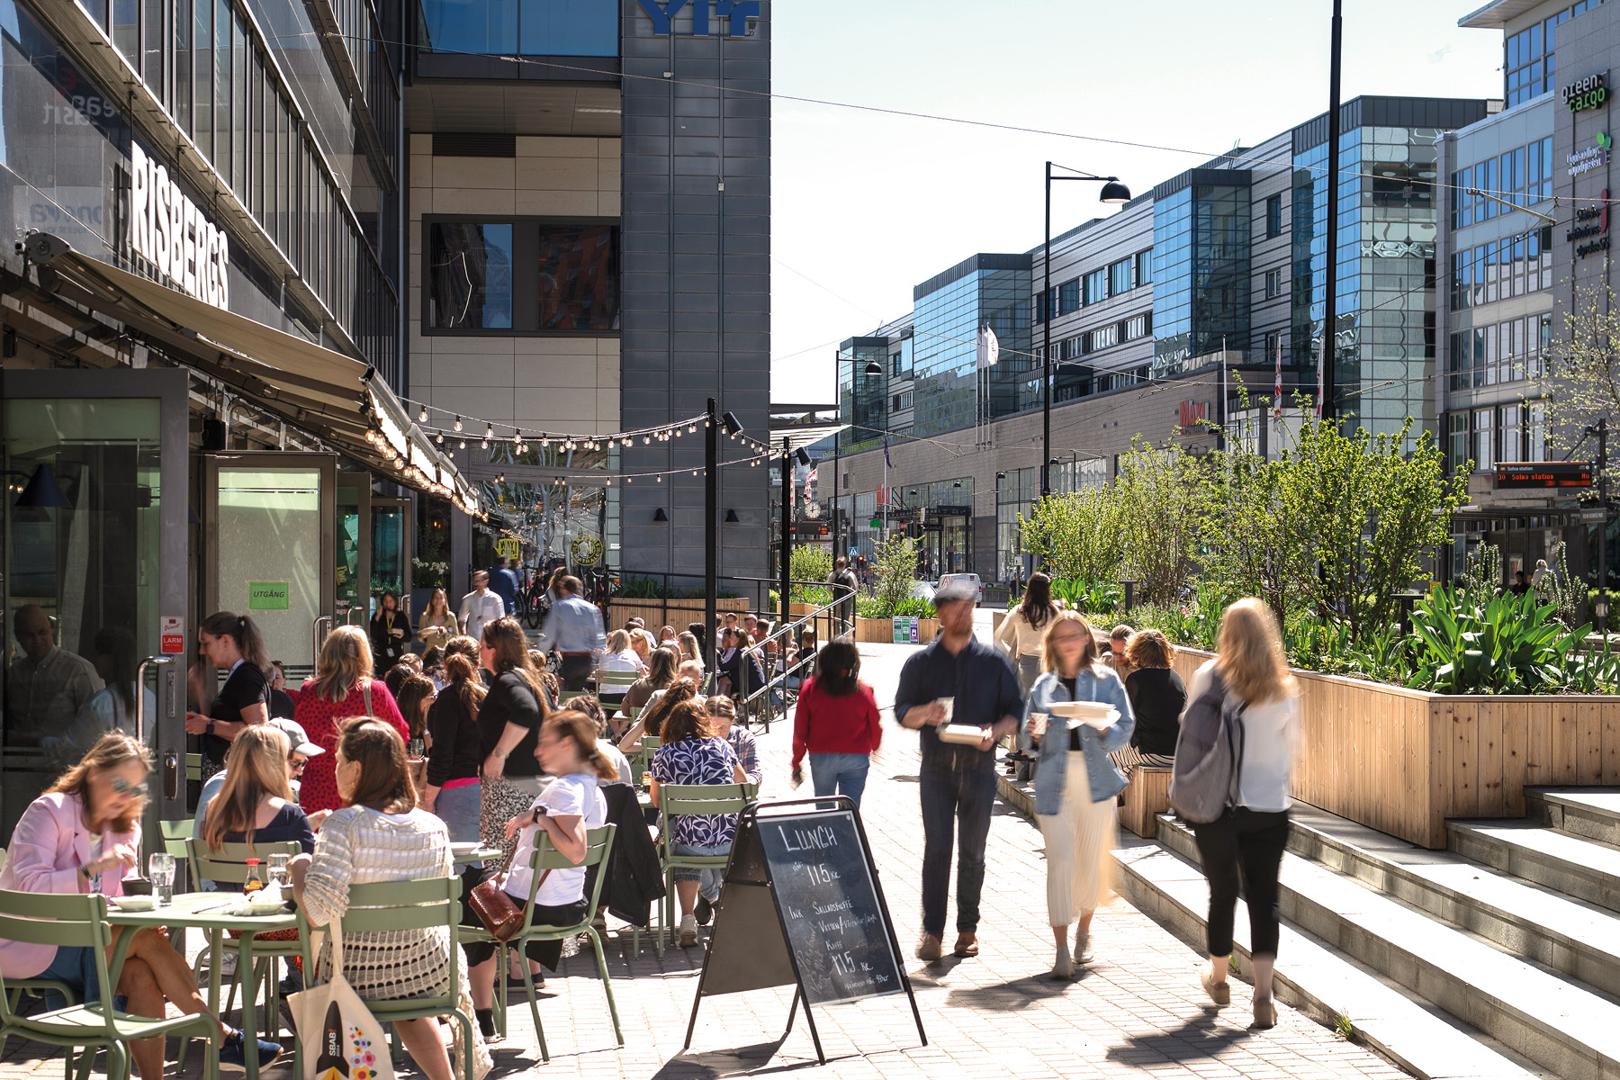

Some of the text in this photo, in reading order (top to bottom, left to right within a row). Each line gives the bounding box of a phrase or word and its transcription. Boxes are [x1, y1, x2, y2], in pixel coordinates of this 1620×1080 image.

[1569, 88, 1605, 112] cargo
[131, 140, 229, 311] RISBERGS
[253, 589, 285, 598] UTGÅNG
[807, 863, 831, 887] 115
[831, 951, 856, 976] 115
